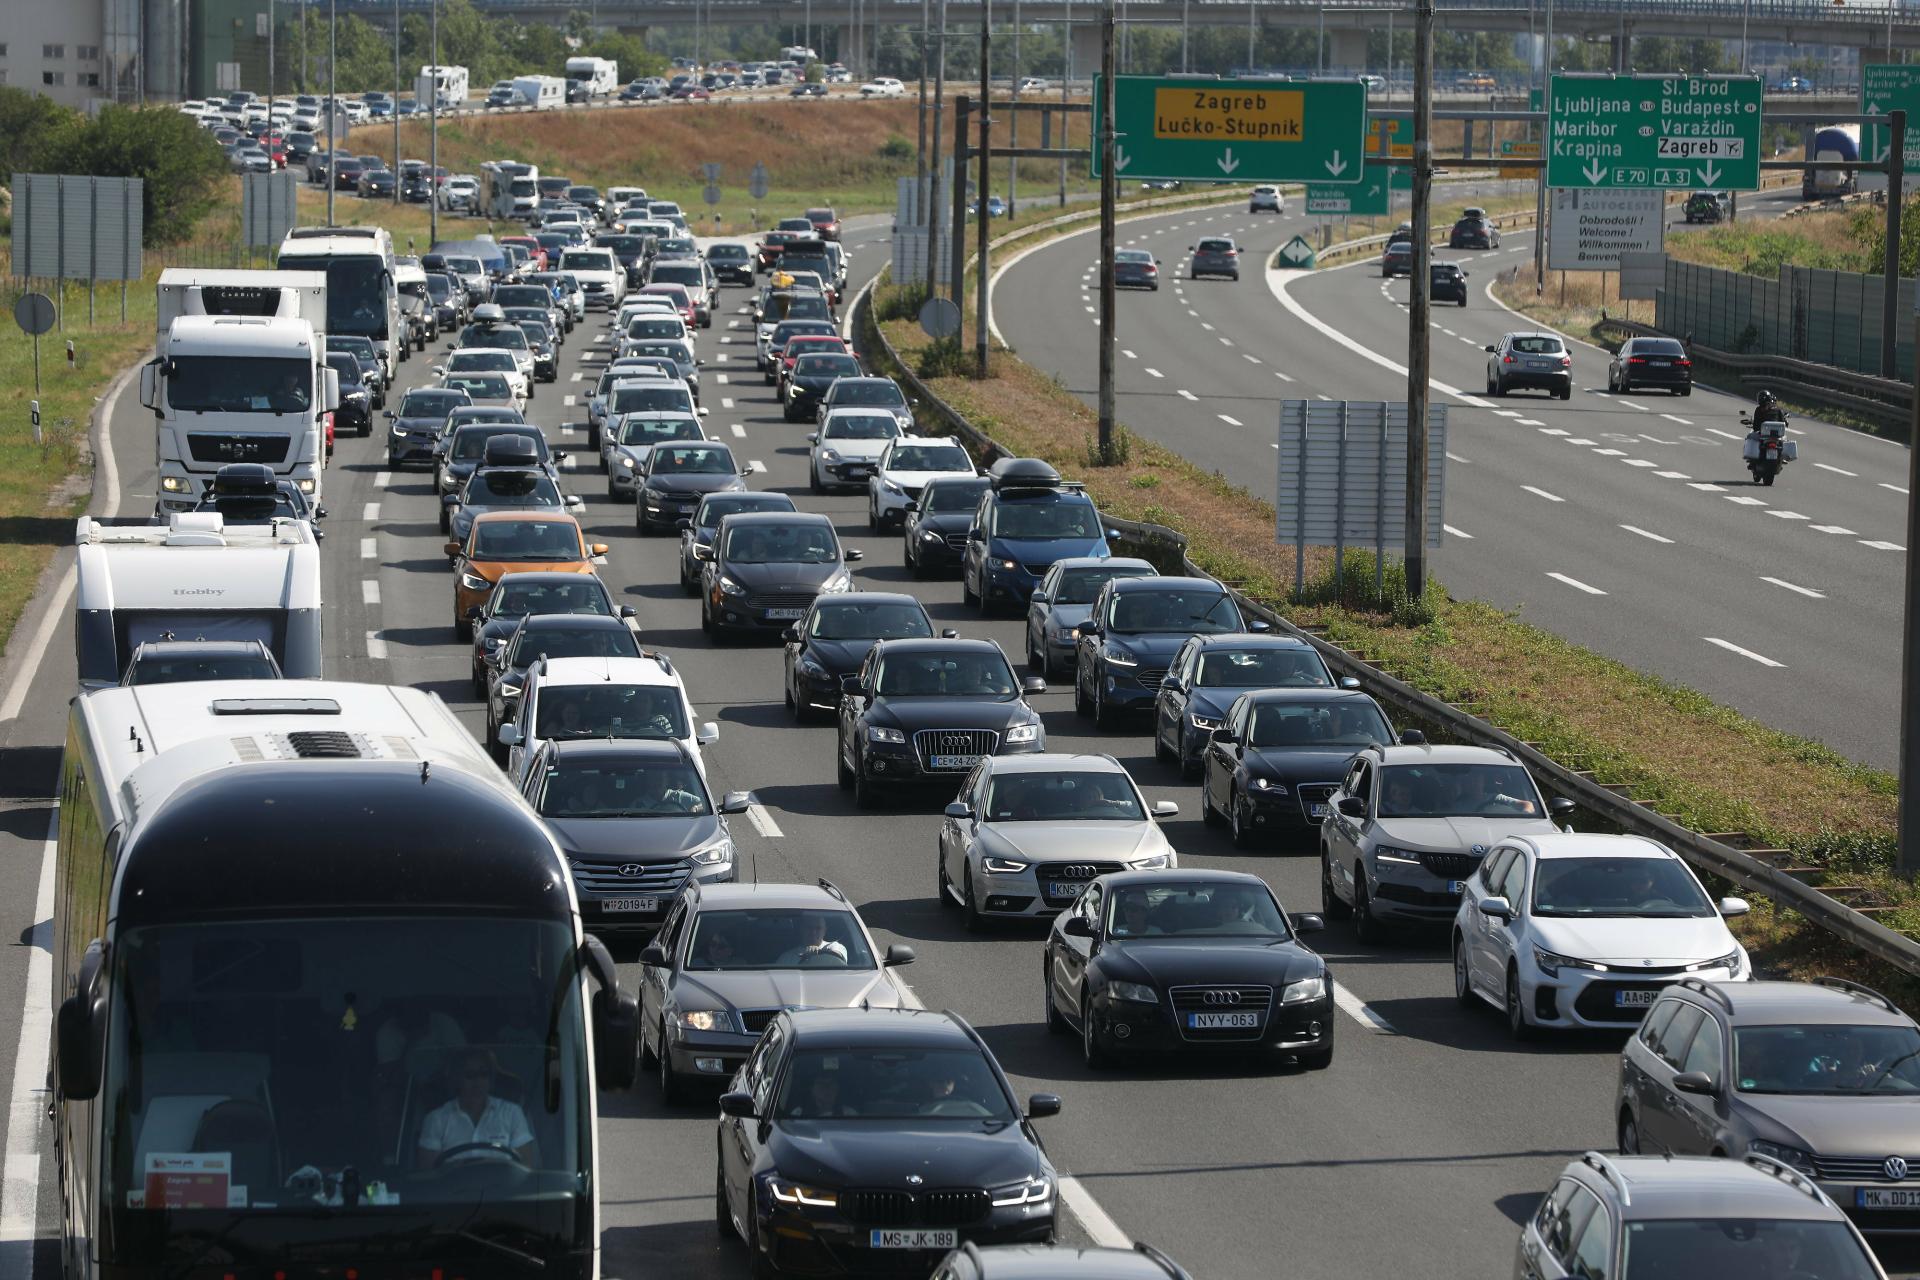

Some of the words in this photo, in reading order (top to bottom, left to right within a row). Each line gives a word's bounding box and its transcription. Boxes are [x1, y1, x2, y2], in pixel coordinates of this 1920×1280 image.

[1662, 79, 1682, 95] Sl.
[1690, 79, 1729, 95] Brod
[1194, 92, 1267, 113] Zagreb
[1554, 97, 1631, 117] Ljubljana
[1661, 99, 1740, 118] Budapest
[1158, 116, 1299, 138] Lučko-Stupnik
[1554, 120, 1618, 136] Maribor
[1661, 119, 1735, 135] Varaždin
[1553, 139, 1622, 160] Krapina
[1659, 138, 1718, 157] Zagreb
[1616, 170, 1625, 182] E
[1629, 170, 1645, 182] 70
[1662, 171, 1670, 183] A
[1676, 171, 1684, 183] 3
[1580, 227, 1626, 237] Welcome
[1579, 240, 1642, 249] Willkommen
[173, 588, 224, 597] Hobby
[1866, 1192, 1881, 1206] MK
[883, 1232, 901, 1246] MS
